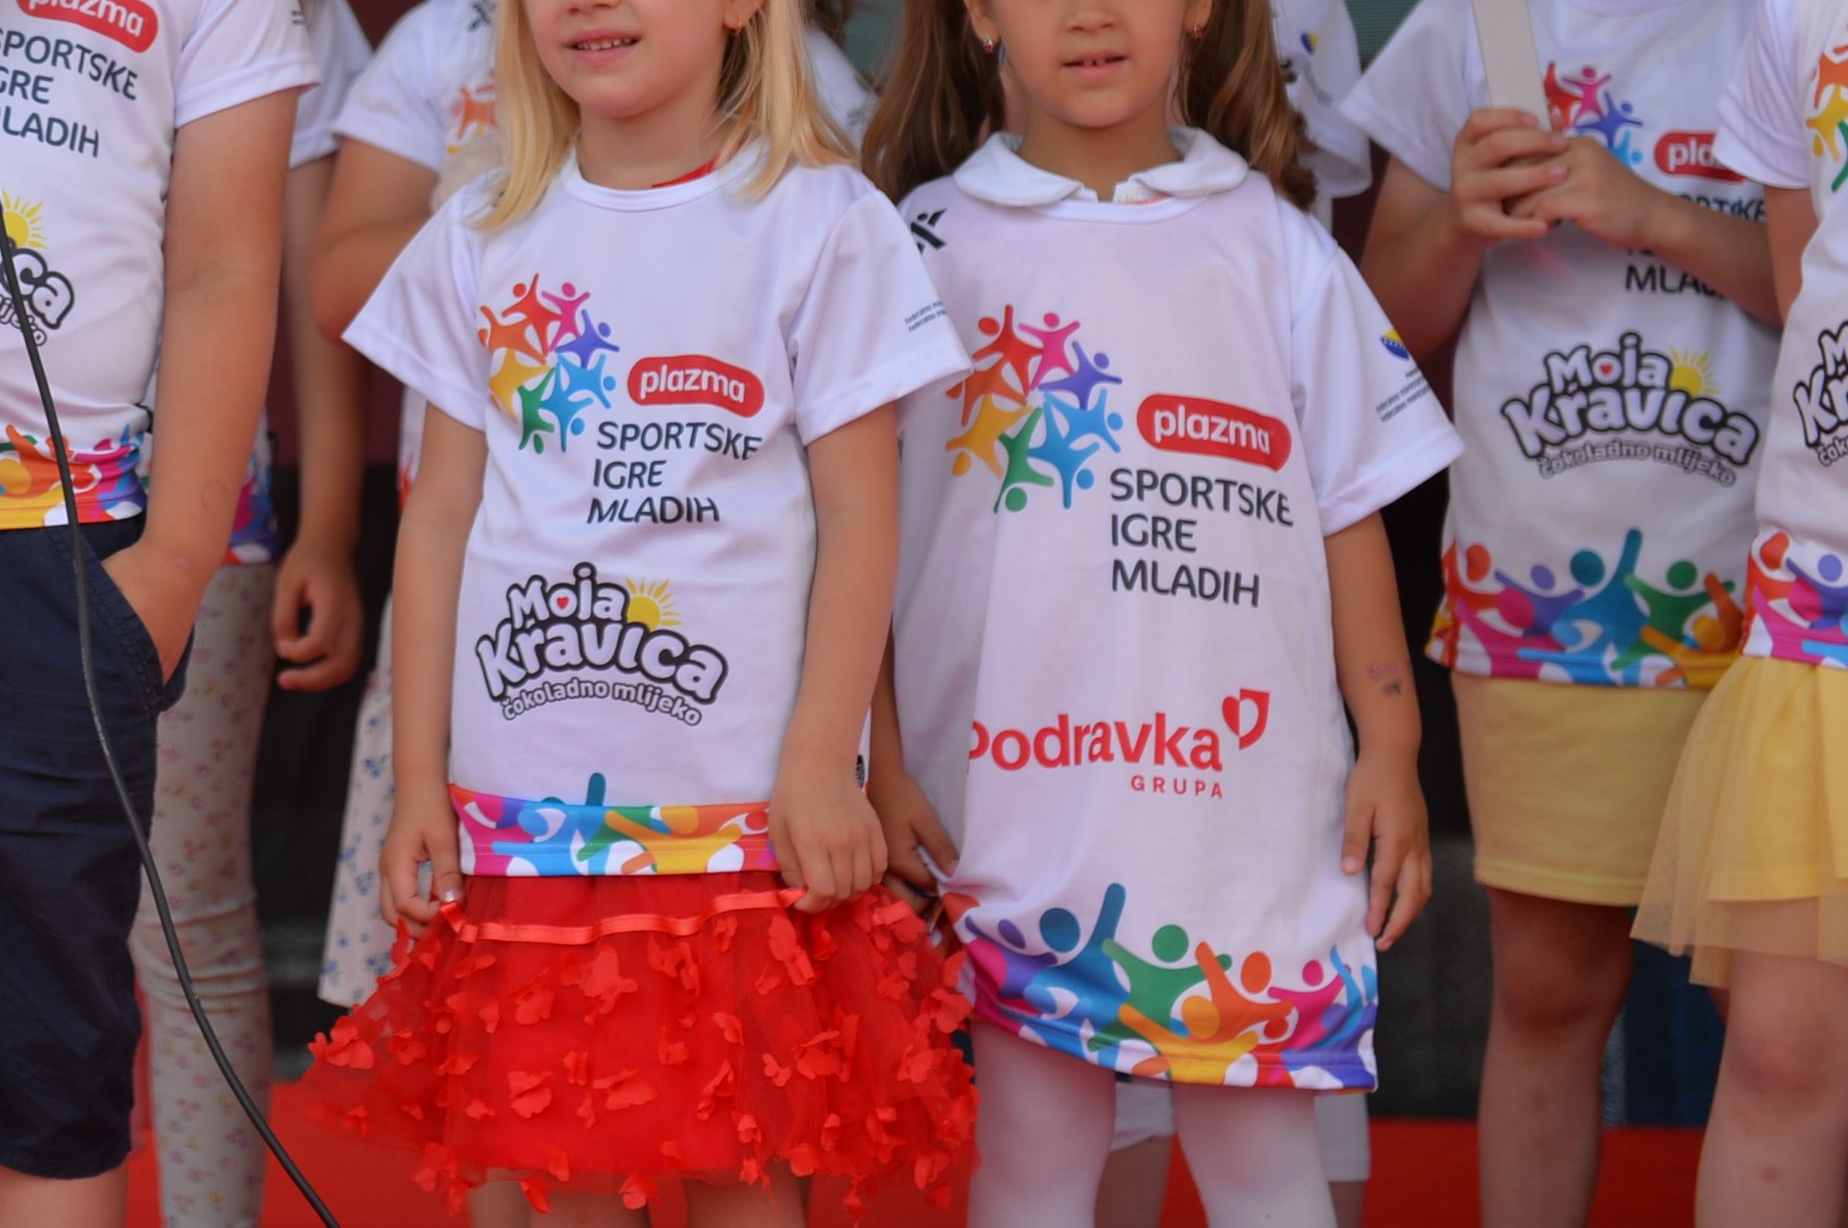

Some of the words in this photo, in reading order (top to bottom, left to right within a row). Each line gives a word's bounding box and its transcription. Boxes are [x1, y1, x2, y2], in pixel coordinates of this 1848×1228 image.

[640, 364, 746, 404] plazma
[1543, 332, 1674, 397] Moja
[596, 421, 763, 461] SPORTSKE
[1153, 404, 1271, 456] plazma
[1501, 384, 1760, 467] Kravica
[593, 458, 667, 490] IGRE
[1534, 439, 1652, 480] čokoladno
[1653, 443, 1737, 488] mlijeko
[587, 496, 720, 524] MLADIH
[1109, 468, 1294, 528] SPORTSKE
[1110, 513, 1197, 553] IGRE
[506, 562, 630, 629] Moja
[1111, 558, 1260, 609] MLADIH
[475, 618, 729, 705] Kravica
[501, 677, 610, 721] čokoladno
[612, 680, 703, 726] mlijeko
[1129, 775, 1224, 800] GRUPA
